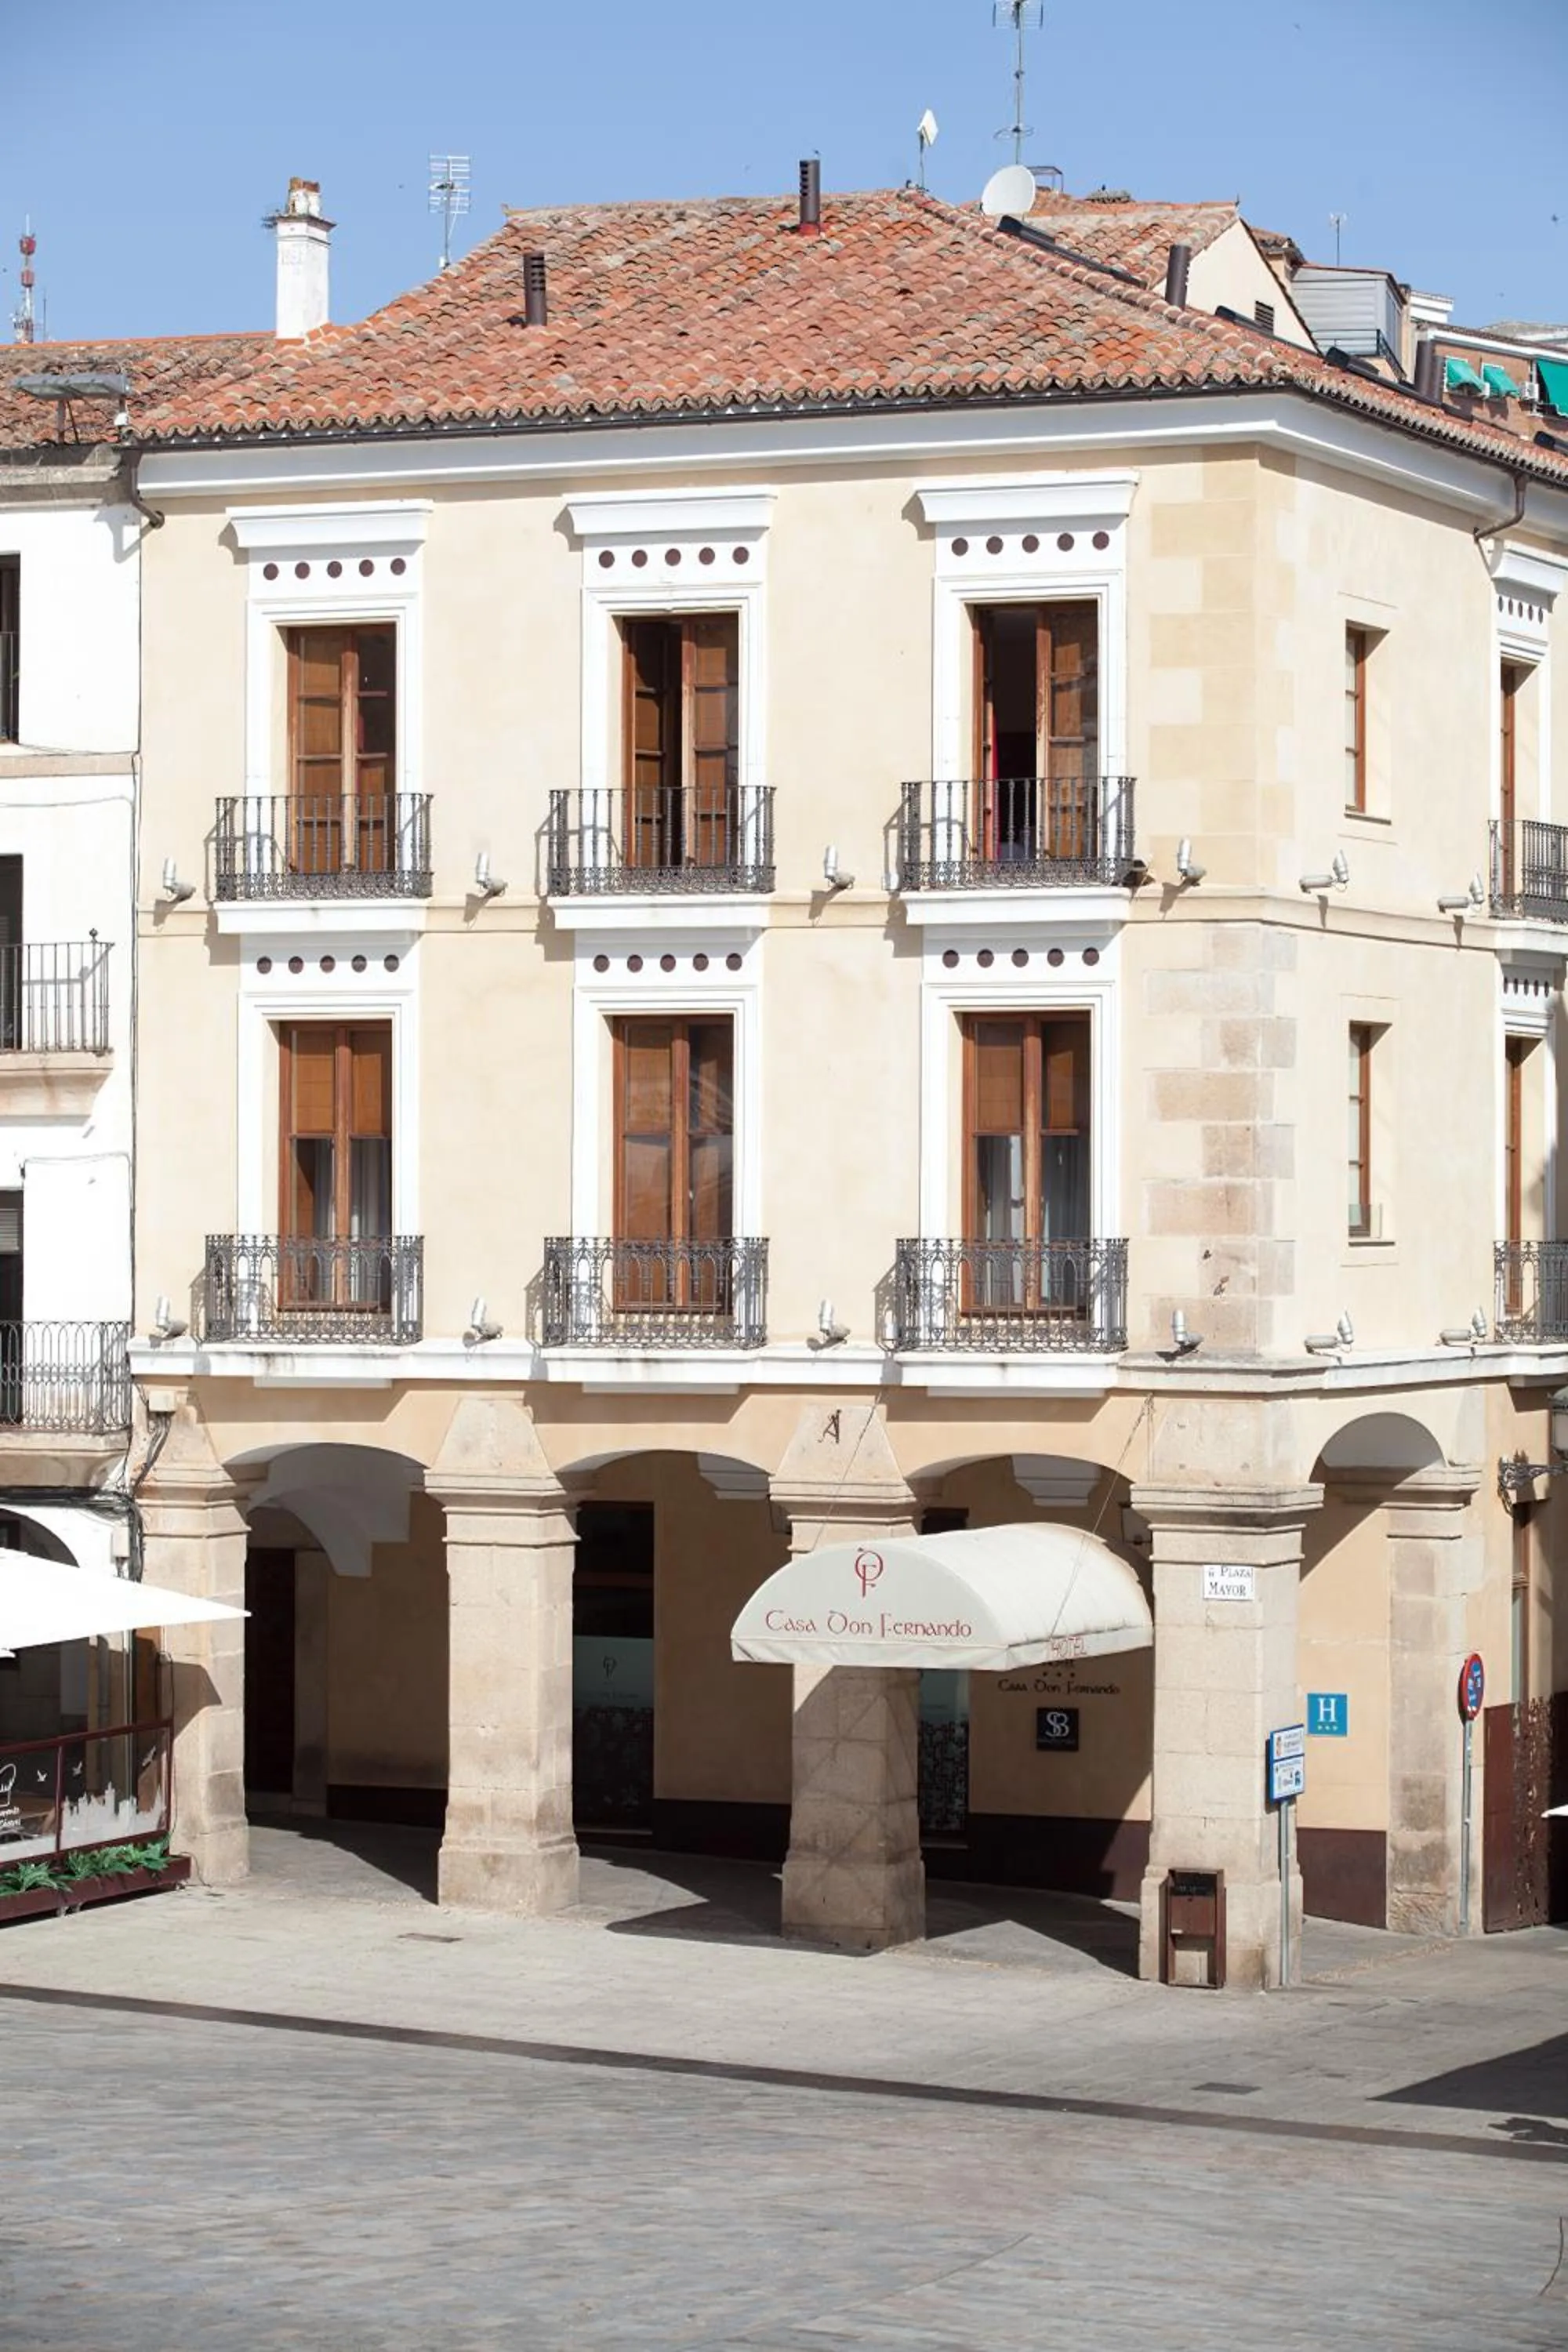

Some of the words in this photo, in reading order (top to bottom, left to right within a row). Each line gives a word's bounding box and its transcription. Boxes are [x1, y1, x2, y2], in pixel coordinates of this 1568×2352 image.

[1220, 1566, 1250, 1578] PLAZA
[1208, 1581, 1247, 1596] MAYOR
[765, 1610, 817, 1633] Casa
[827, 1610, 873, 1635] Don
[880, 1613, 972, 1639] Fernando
[1051, 1636, 1087, 1659] HOTEL
[1318, 1697, 1338, 1722] H
